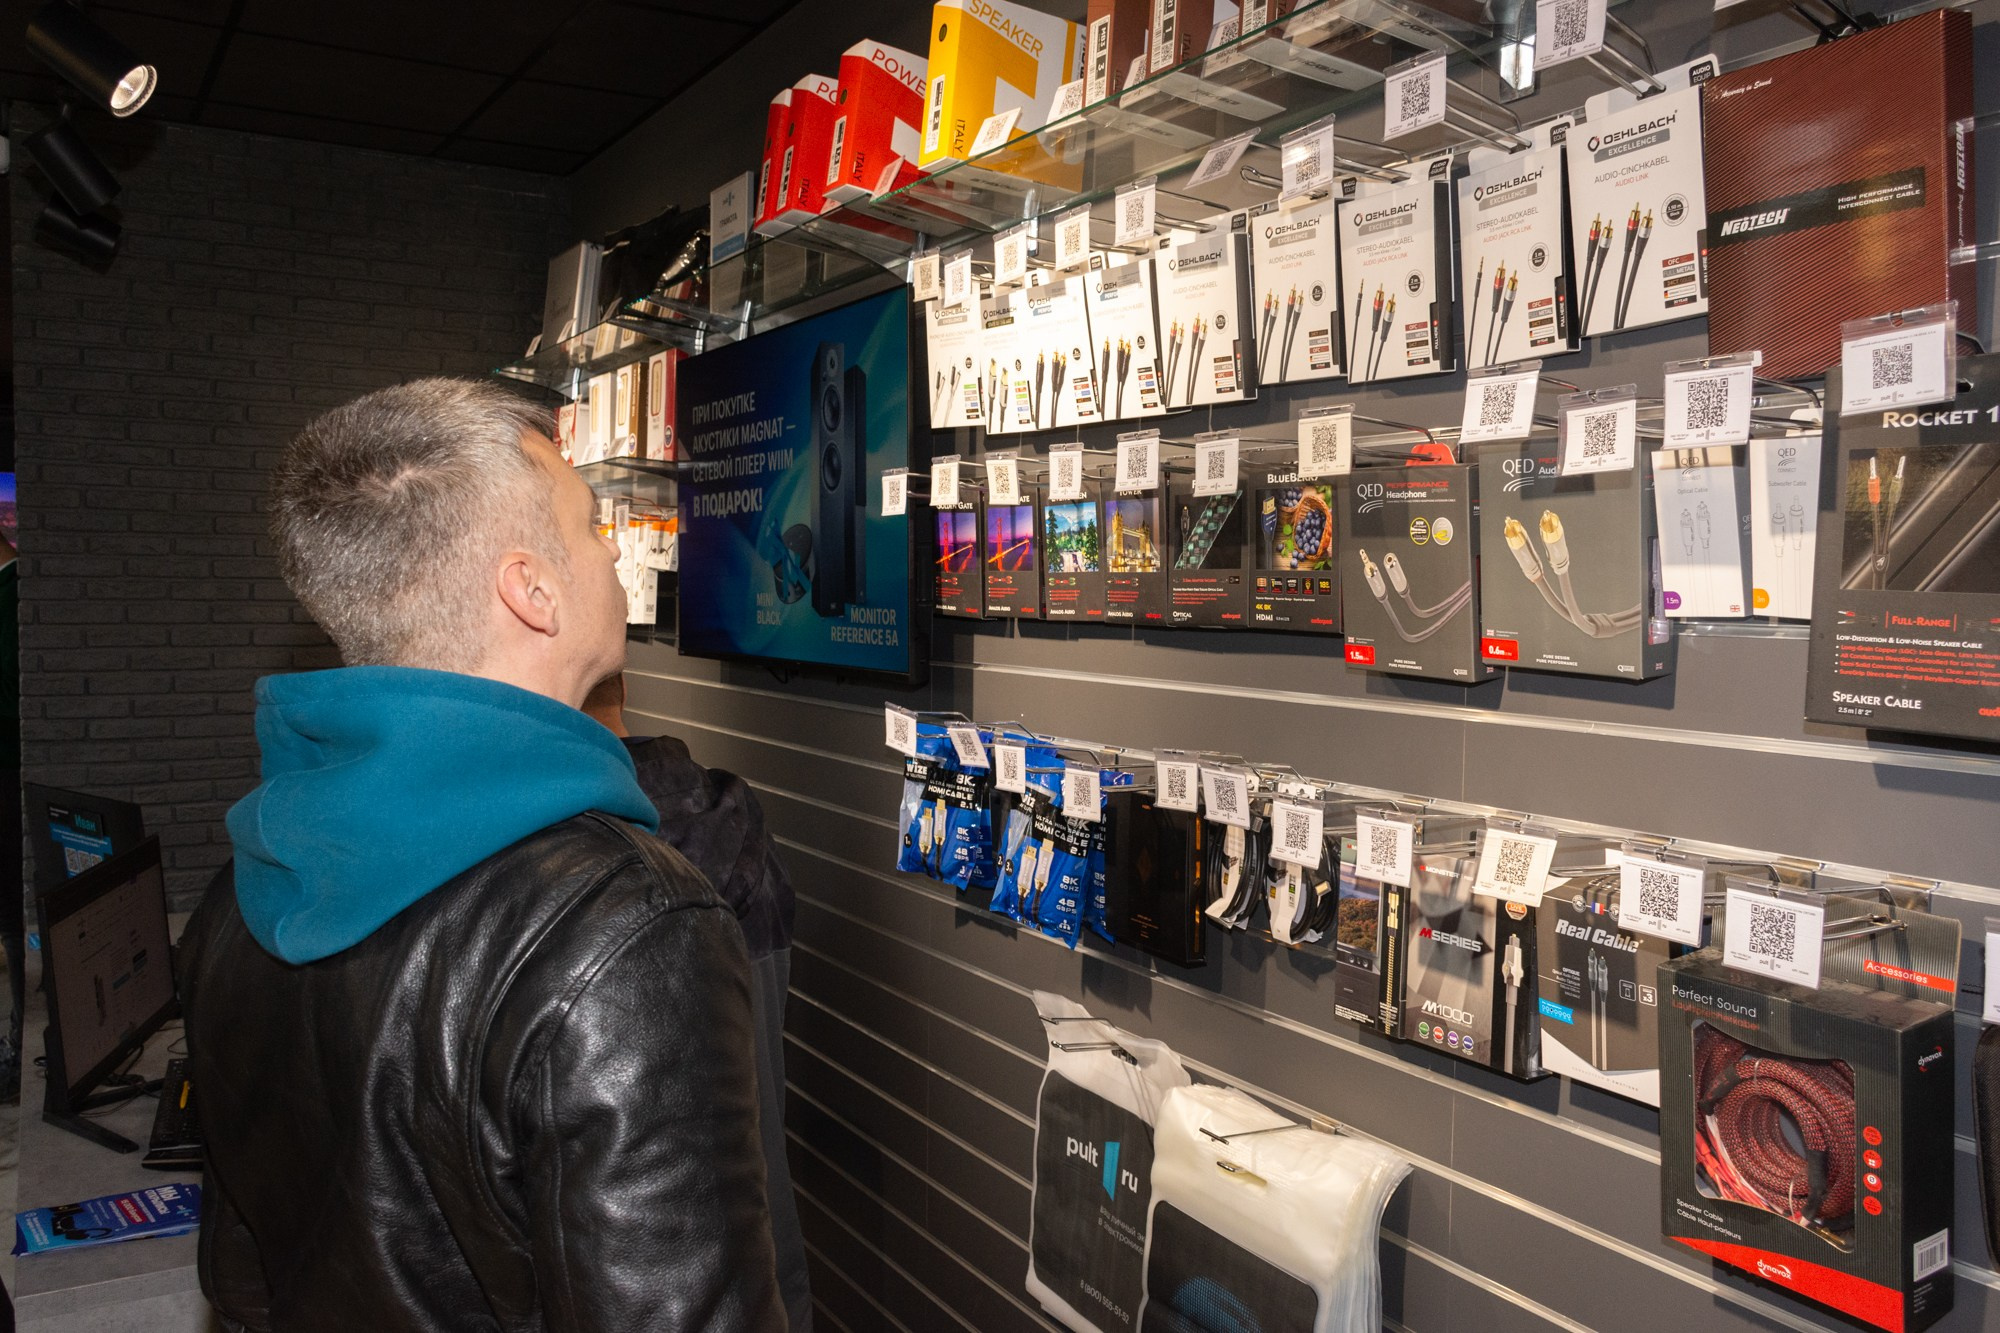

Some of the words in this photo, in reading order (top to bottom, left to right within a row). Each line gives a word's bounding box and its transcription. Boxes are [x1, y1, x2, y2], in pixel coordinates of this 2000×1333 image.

[970, 0, 1044, 57] SPEAKER
[872, 48, 926, 97] POWE
[1098, 62, 1105, 71] 3
[1692, 65, 1711, 76] AUDIO
[1693, 72, 1711, 83] EQUIP
[954, 119, 965, 153] ITALY
[1603, 114, 1676, 145] OEHLBACH
[1608, 135, 1657, 156] EXCELLENCE
[854, 151, 865, 183] ITALY
[1594, 155, 1670, 184] AUDIO-CINCHKABEL
[1486, 170, 1542, 195] OEHLBACH
[1615, 177, 1635, 188] AUDIO
[1635, 173, 1649, 184] LINK
[800, 178, 810, 207] ITALY
[1489, 189, 1528, 206] EXCELLENCE
[1838, 193, 1857, 205] HIGH
[1859, 183, 1914, 199] PERFORMANCE
[1838, 195, 1894, 211] INTERCONNECT
[1896, 189, 1921, 199] CABLE
[1365, 202, 1417, 222] OEHLBACH
[1476, 207, 1539, 231] STEREO-AUDIOKABEL
[1275, 218, 1320, 236] OEHLBACH
[1369, 217, 1403, 232] EXCELLENCE
[1356, 236, 1414, 255] STEREO-AUDIOKABEL
[1178, 251, 1221, 267] OEHLBACH
[692, 405, 709, 425] ПРИ
[711, 391, 756, 420] ПОКУПКЕ
[1882, 409, 1978, 428] ROCKET
[692, 429, 739, 454] АКУСТИКИ
[741, 417, 784, 444] MAGNAT
[1681, 456, 1700, 466] QED
[1778, 448, 1796, 458] QED
[692, 454, 733, 483] СЕТЕВОЙ
[734, 457, 764, 477] ПЛЕЕР
[1502, 458, 1534, 477] QED
[1357, 483, 1384, 500] QED
[1386, 481, 1449, 489] PERFORMANCE
[693, 496, 699, 517] В
[702, 488, 763, 519] ПОДАРОК!
[1019, 495, 1030, 503] ATE
[1386, 491, 1427, 499] Headphone
[958, 501, 973, 510] GATE
[756, 610, 781, 626] BLACK
[850, 606, 897, 626] MONITOR
[1256, 613, 1273, 621] HDMI
[1891, 616, 1951, 627] FULL-RANGE
[831, 626, 883, 644] REFERENCE
[885, 629, 899, 647] 5A
[1836, 634, 1887, 643] LOW-DISTORTION
[1896, 638, 1932, 646] LOW-NOISE
[1933, 639, 1960, 648] SPEAKER
[1961, 641, 1983, 649] CABLE
[1832, 690, 1881, 706] SPEAKER
[1884, 695, 1922, 709] CABLE
[928, 785, 945, 795] HDMI
[946, 789, 973, 801] CABLE
[960, 801, 973, 809] 2.1
[1035, 815, 1053, 826] ULTRA
[1035, 821, 1054, 835] HDMI
[1055, 830, 1088, 847] CABLE
[1070, 846, 1087, 857] 2.1
[1063, 875, 1079, 885] 8K
[1425, 866, 1460, 878] MONSTER
[1056, 904, 1077, 914] GBPS
[1555, 919, 1590, 941] Real
[1592, 927, 1639, 953] Cable
[1866, 961, 1928, 985] Accessories
[1642, 993, 1653, 1003] x3
[1672, 984, 1713, 1005] Perfect
[1717, 997, 1757, 1018] Sound
[1422, 1000, 1472, 1025] M1000
[1918, 1050, 1943, 1066] dynavox
[1066, 1134, 1099, 1168] pult
[1121, 1167, 1139, 1194] ru
[1676, 1198, 1702, 1214] Speaker
[1703, 1209, 1724, 1223] Cable
[1110, 1215, 1136, 1237] личный
[1697, 1216, 1742, 1241] Haut-parleurs
[1756, 1258, 1792, 1280] dynavox
[1084, 1283, 1102, 1302] (800)
[1102, 1296, 1130, 1325] 555-51-52
